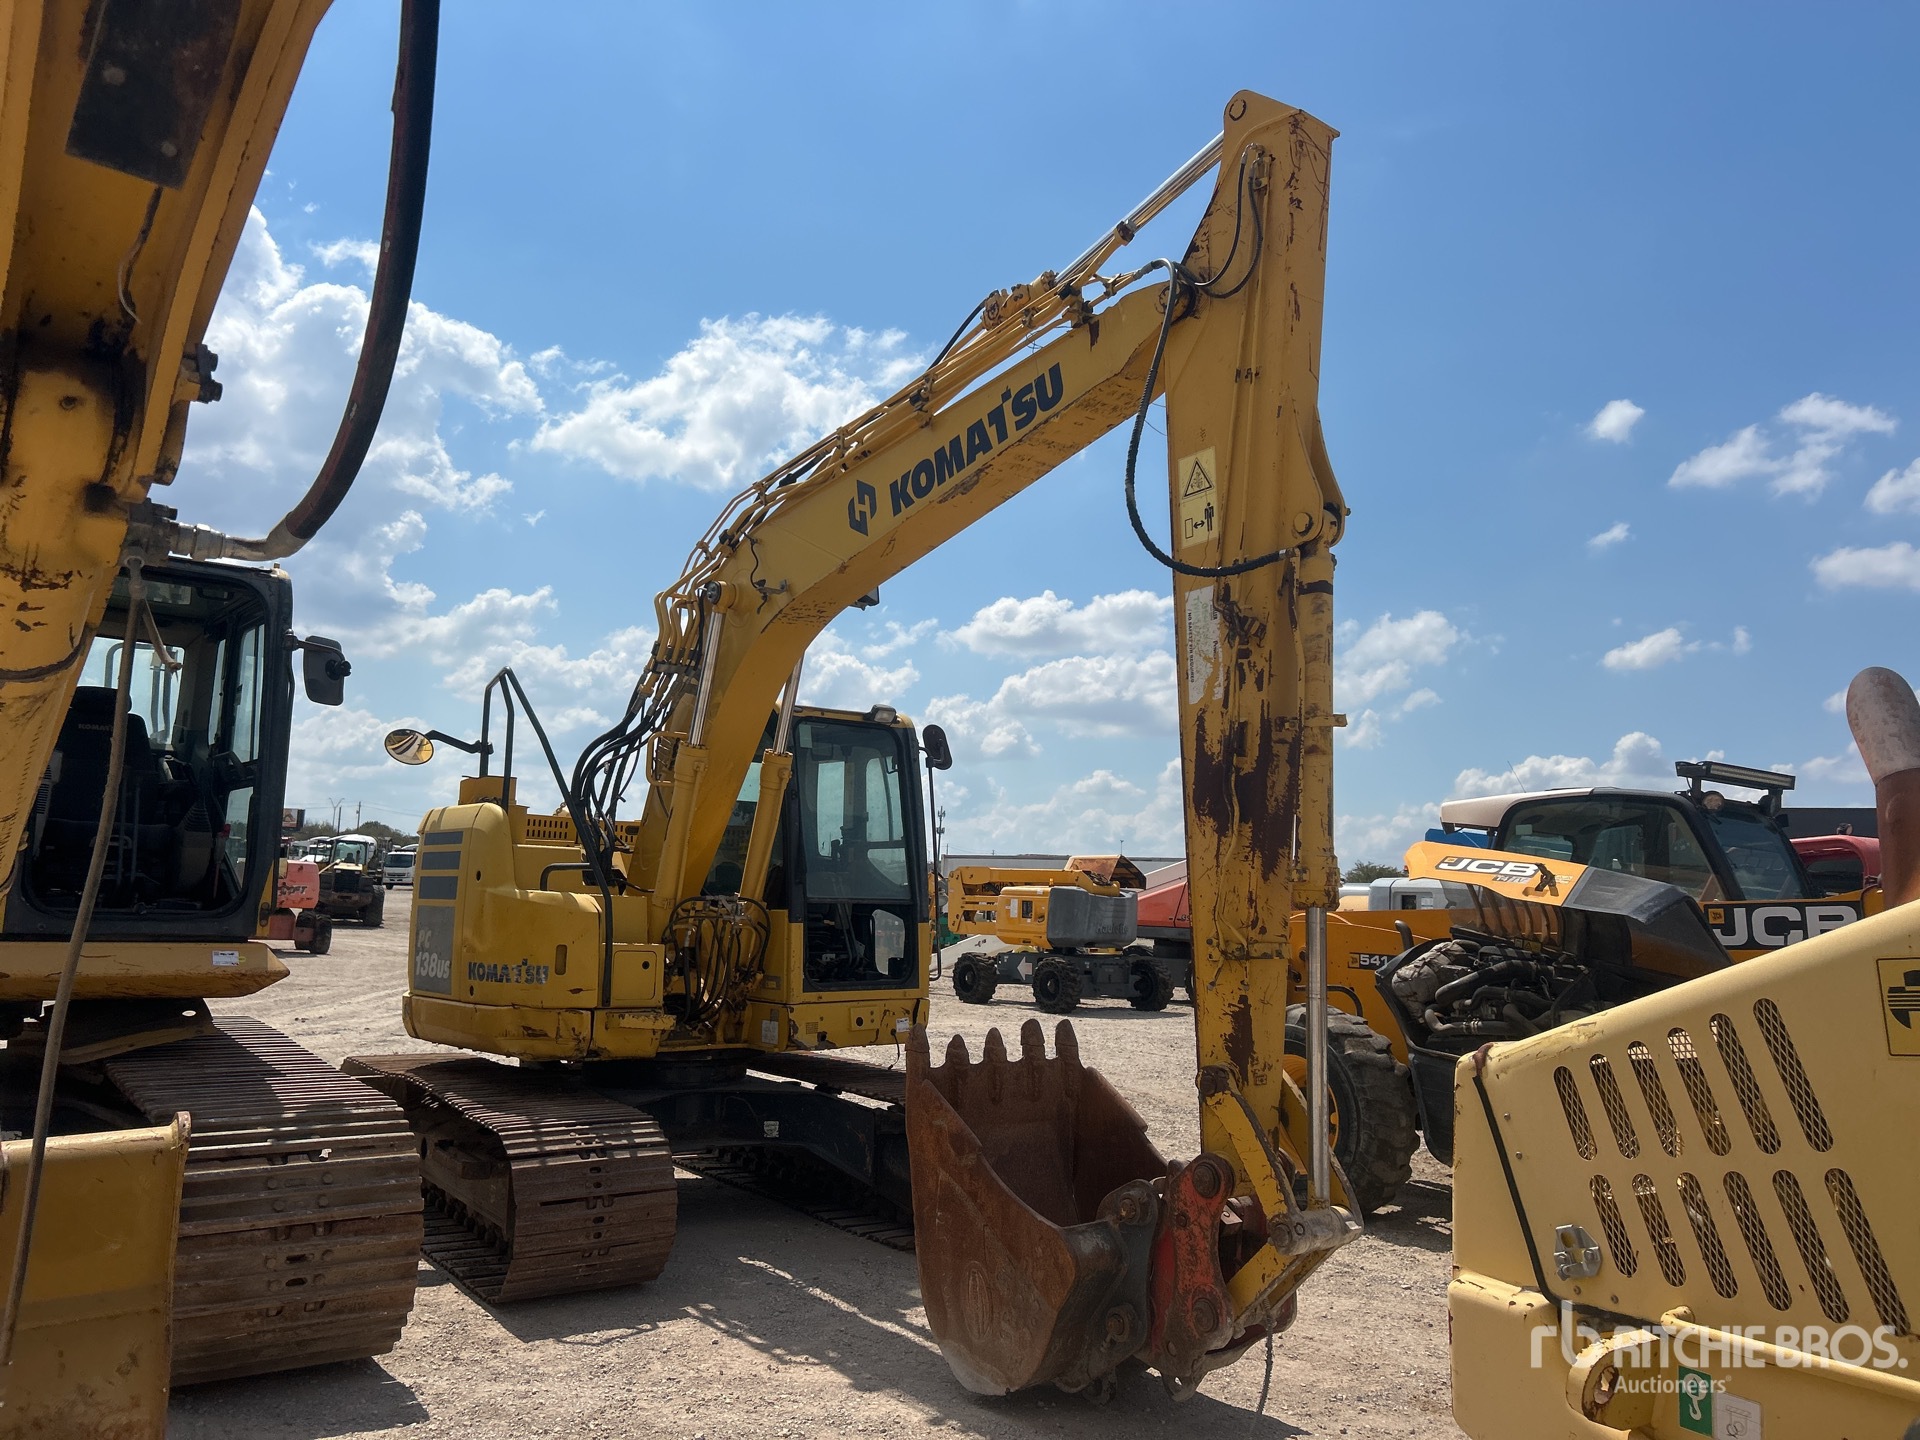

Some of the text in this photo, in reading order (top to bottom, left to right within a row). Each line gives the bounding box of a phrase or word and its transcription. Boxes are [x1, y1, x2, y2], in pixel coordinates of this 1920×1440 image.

[889, 362, 1064, 517] KOMATSU
[1438, 858, 1541, 877] JCB
[417, 930, 432, 948] PC
[468, 958, 549, 985] KOMATSU
